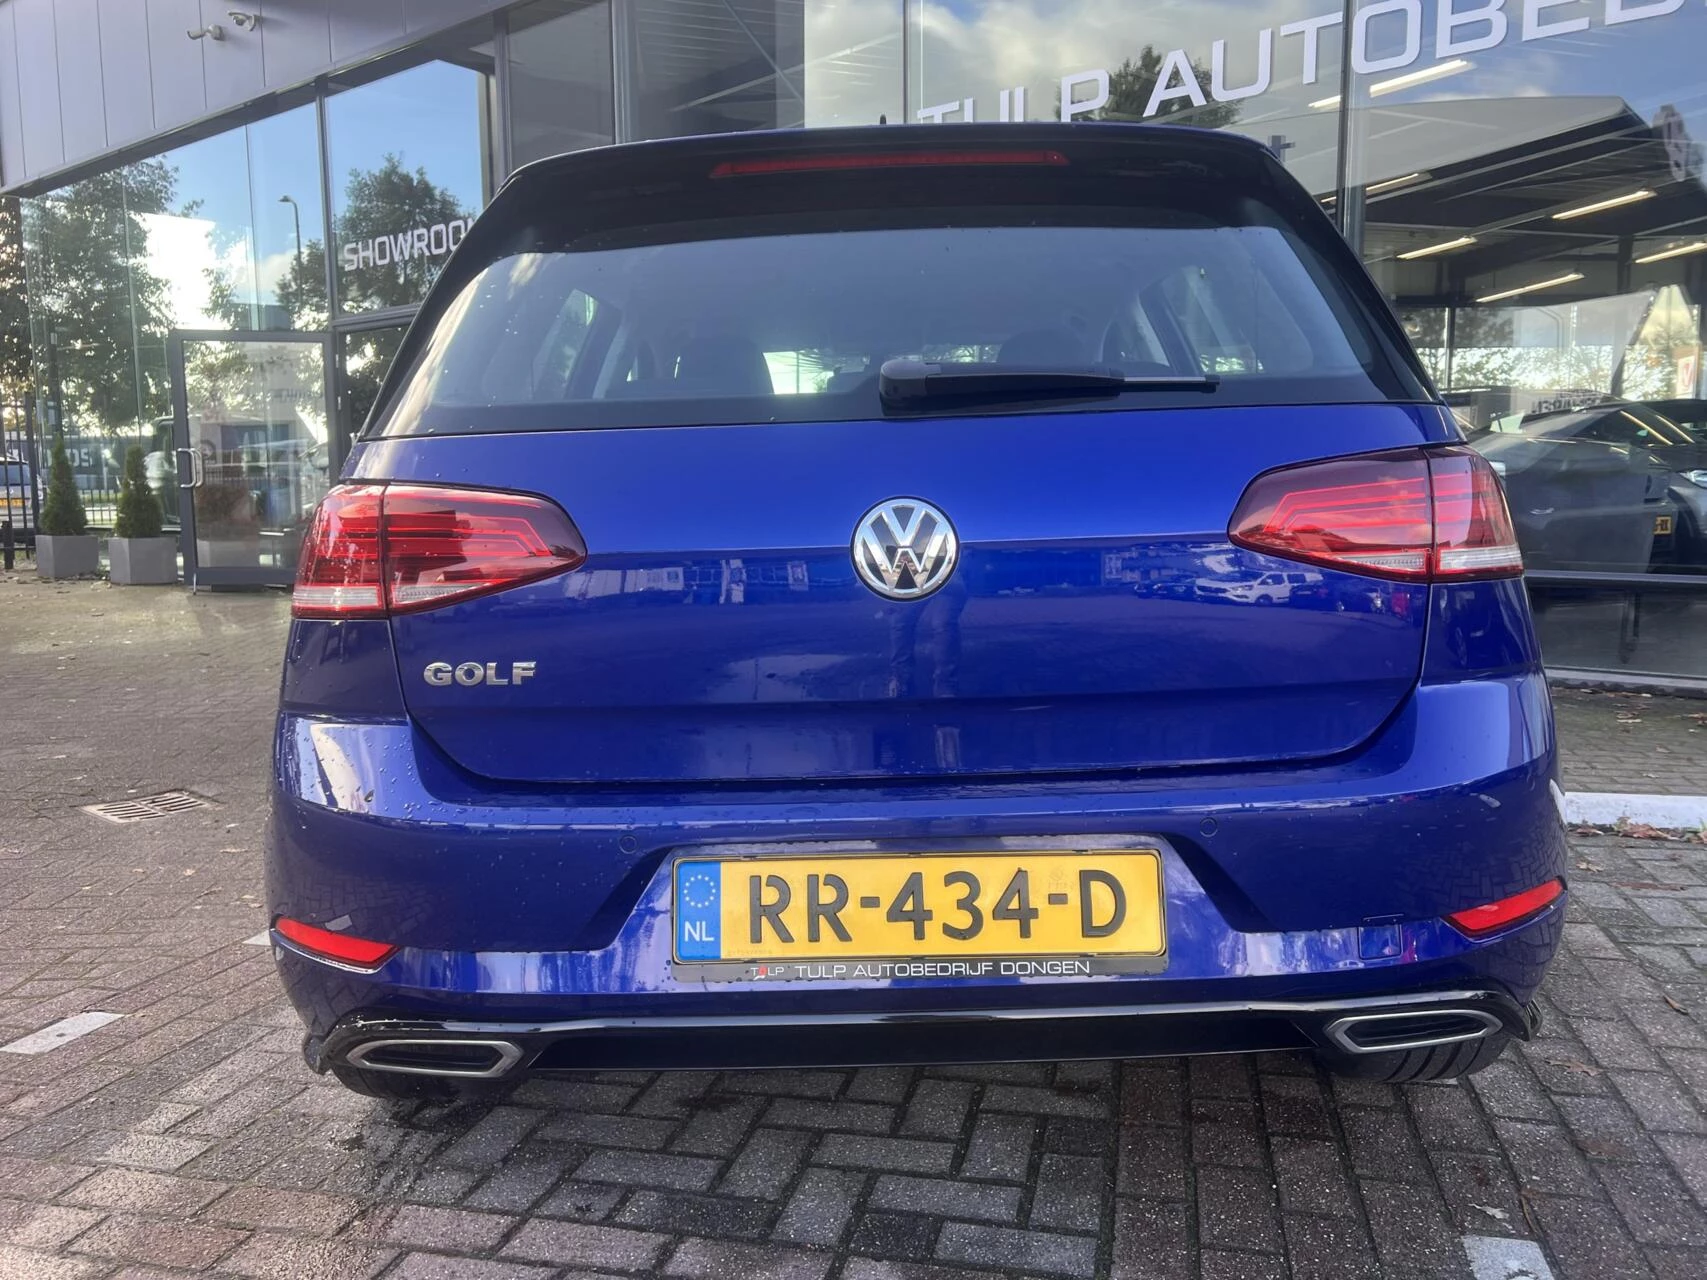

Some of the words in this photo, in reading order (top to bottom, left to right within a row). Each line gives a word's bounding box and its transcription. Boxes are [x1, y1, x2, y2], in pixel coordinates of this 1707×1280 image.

[343, 218, 475, 271] SHOWROO
[423, 661, 537, 686] GOLF
[749, 867, 1127, 944] RR-434-D
[684, 920, 714, 942] NL
[795, 964, 847, 978] TULP
[853, 962, 993, 977] AUTOBEDRIJF
[1000, 961, 1090, 975] DONGEN
